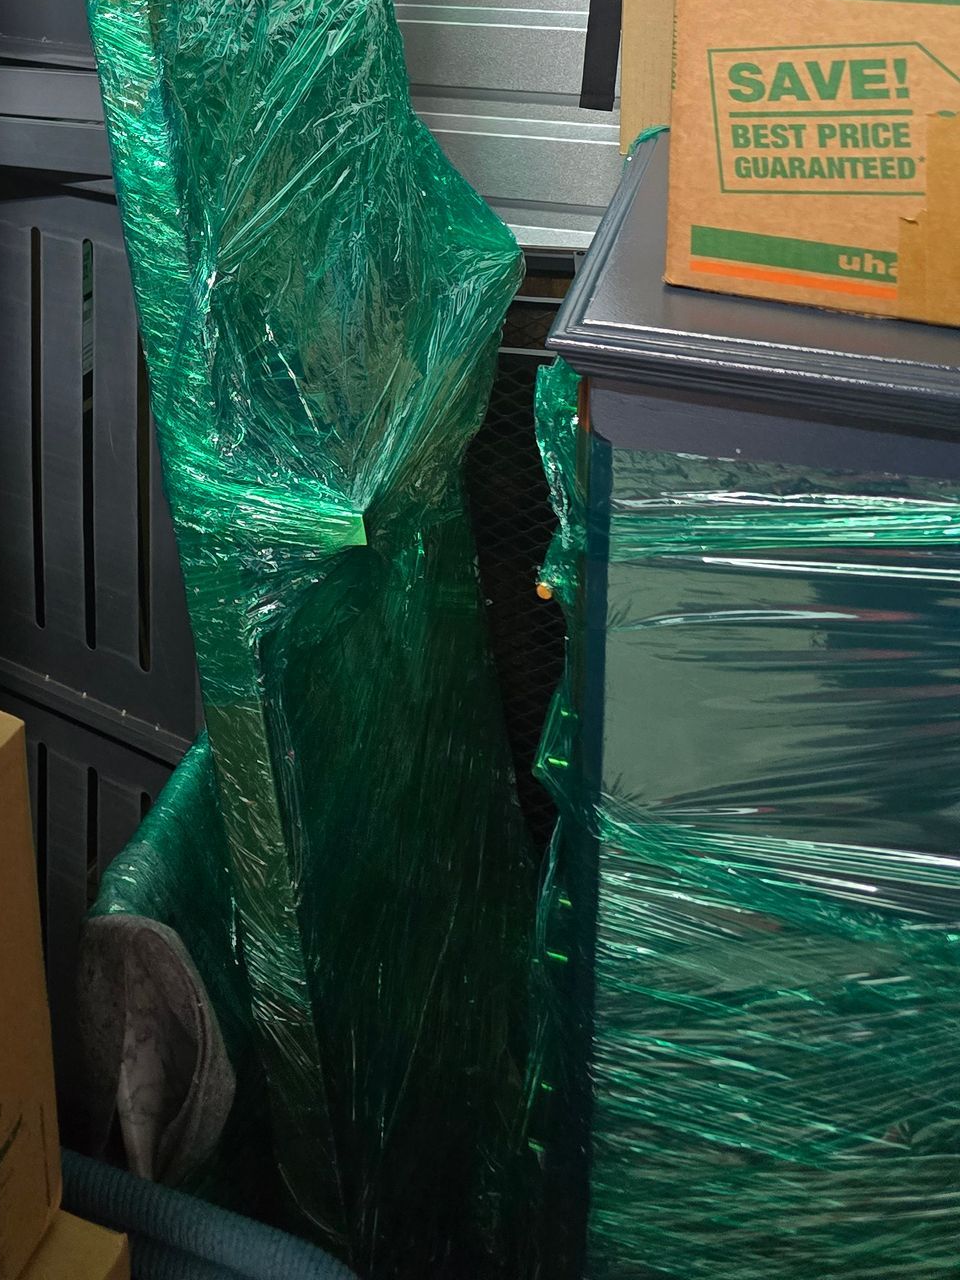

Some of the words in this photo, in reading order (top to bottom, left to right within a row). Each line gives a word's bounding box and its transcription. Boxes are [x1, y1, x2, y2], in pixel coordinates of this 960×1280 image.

[728, 58, 910, 103] SAVE!
[731, 124, 806, 149] BEST
[817, 122, 911, 148] PRICE
